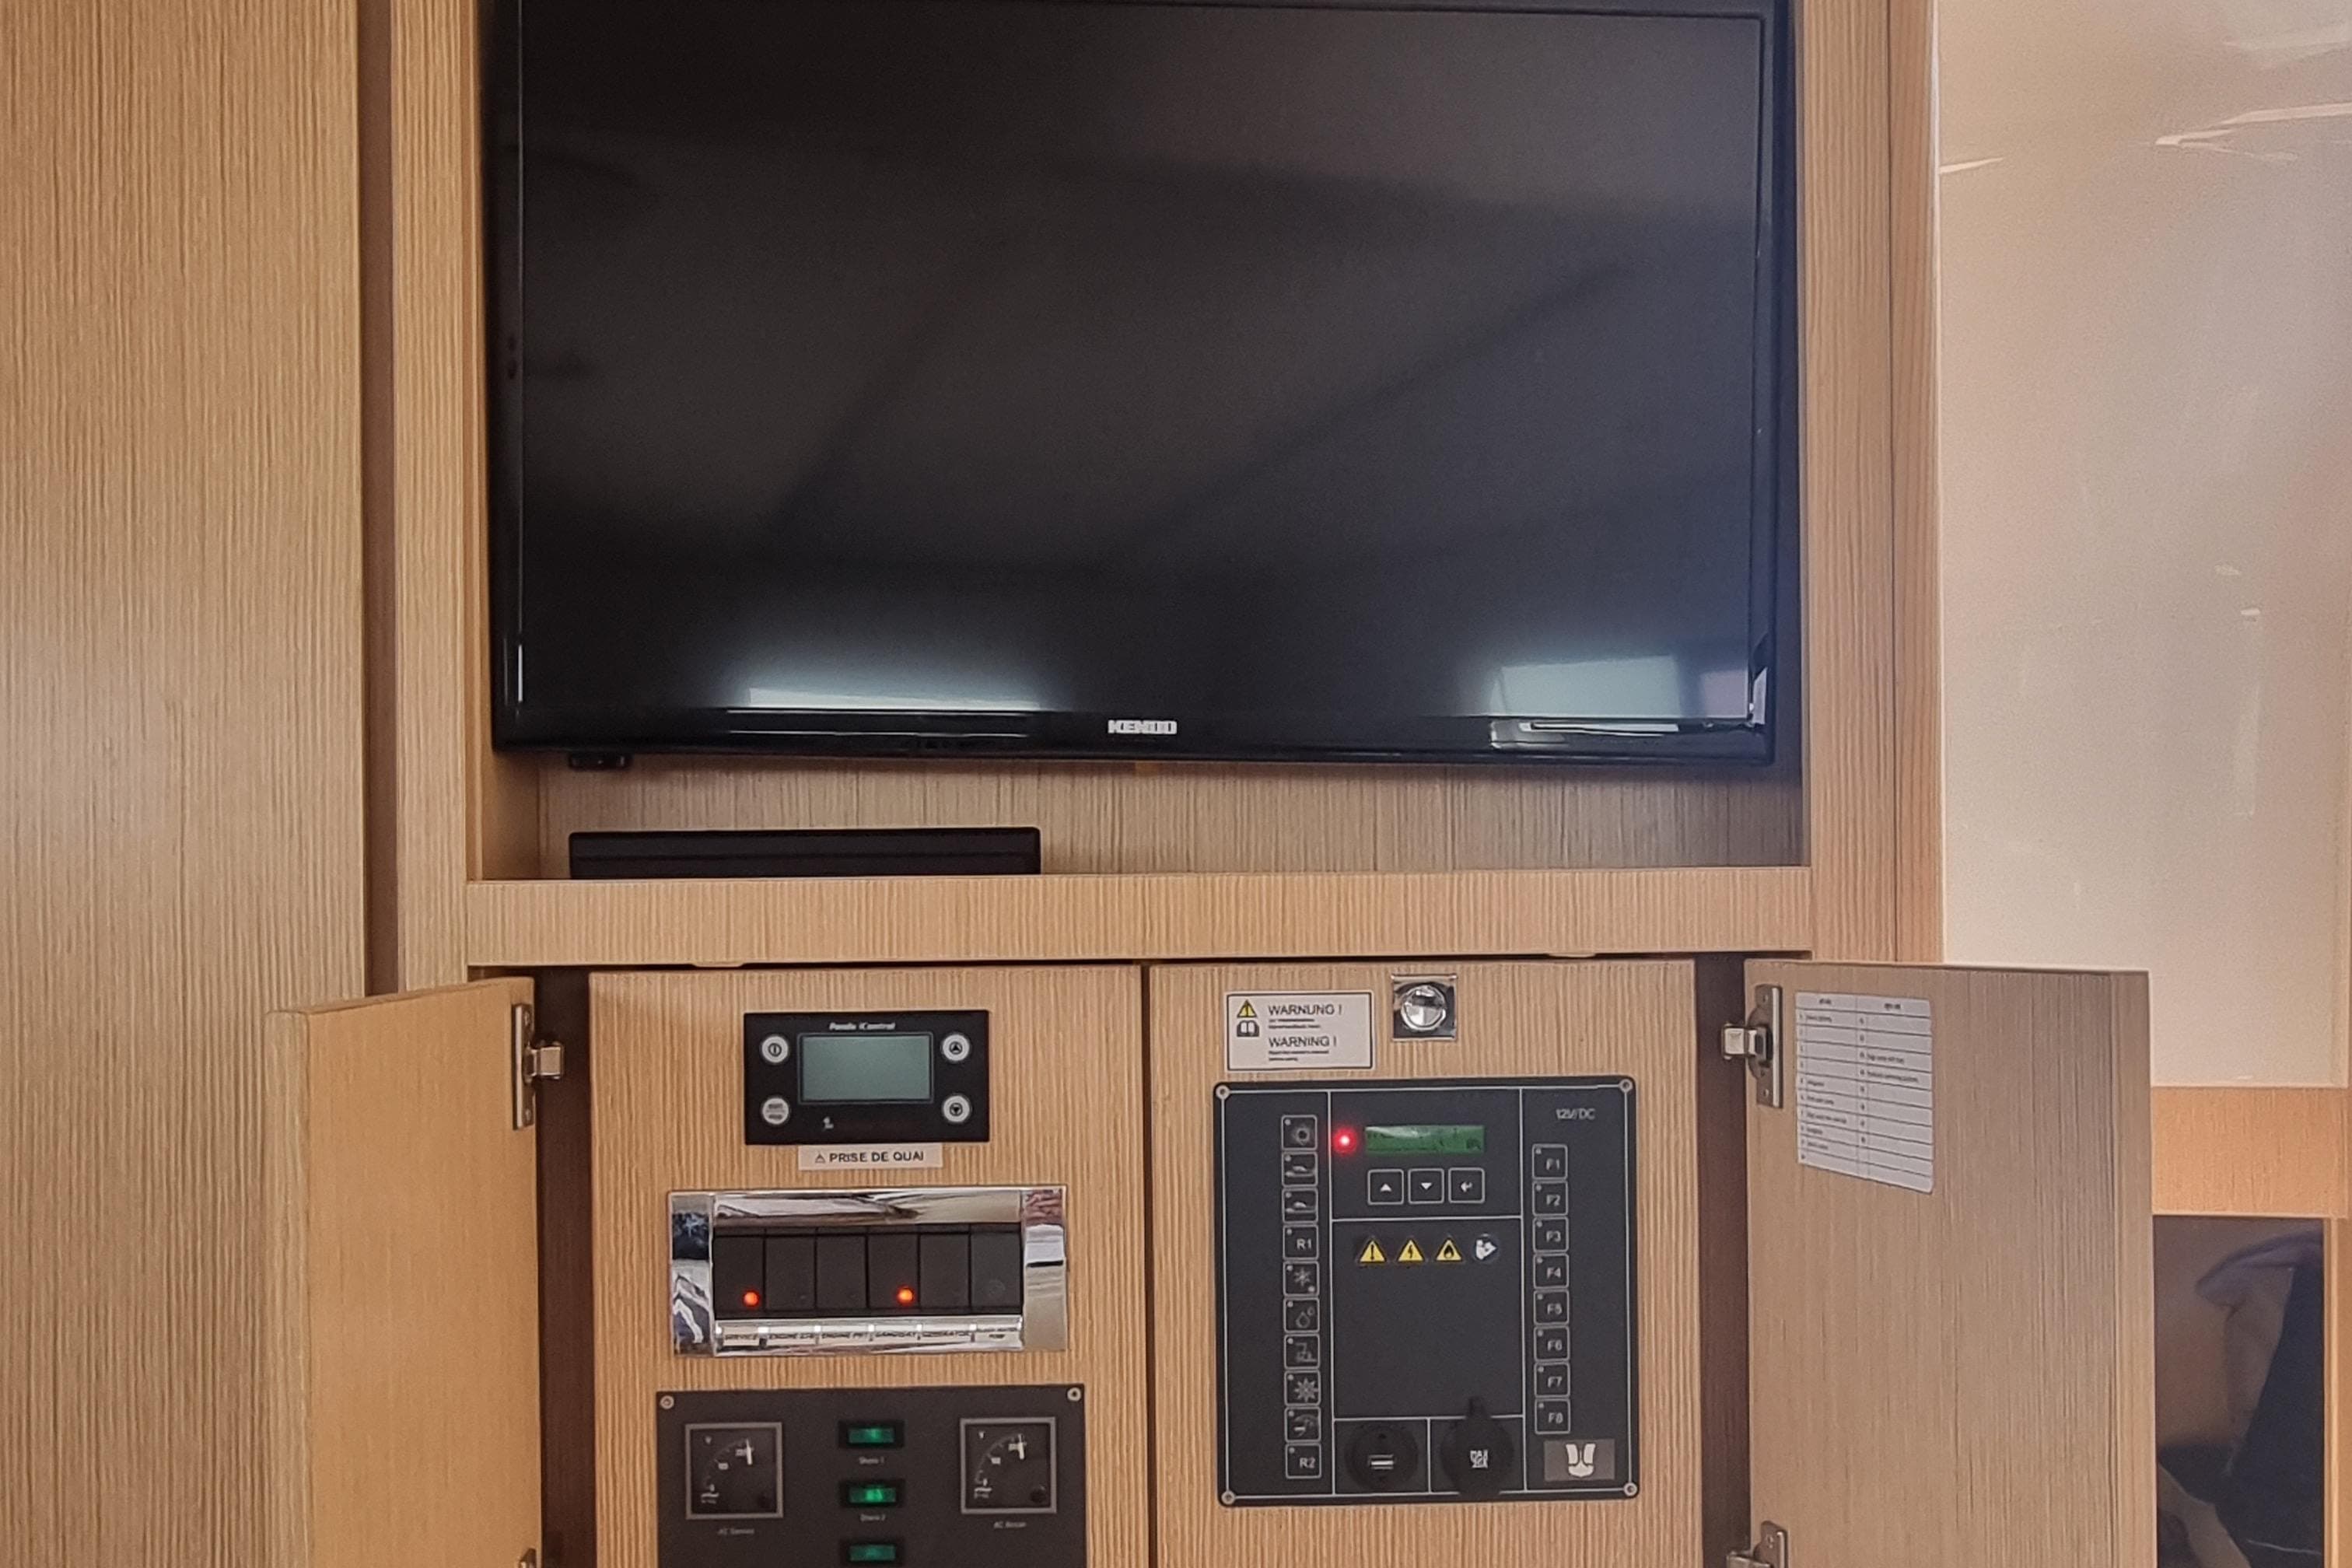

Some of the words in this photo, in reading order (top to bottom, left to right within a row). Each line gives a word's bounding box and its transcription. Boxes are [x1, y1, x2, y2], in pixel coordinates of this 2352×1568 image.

[1268, 1004, 1335, 1016] WARNUNG
[1268, 1036, 1330, 1048] WARNING
[829, 1152, 867, 1163] PRISE
[871, 1152, 889, 1162] DE
[894, 1151, 924, 1161] QUAI
[1296, 1239, 1312, 1250] R1
[1299, 1456, 1316, 1468] R2
